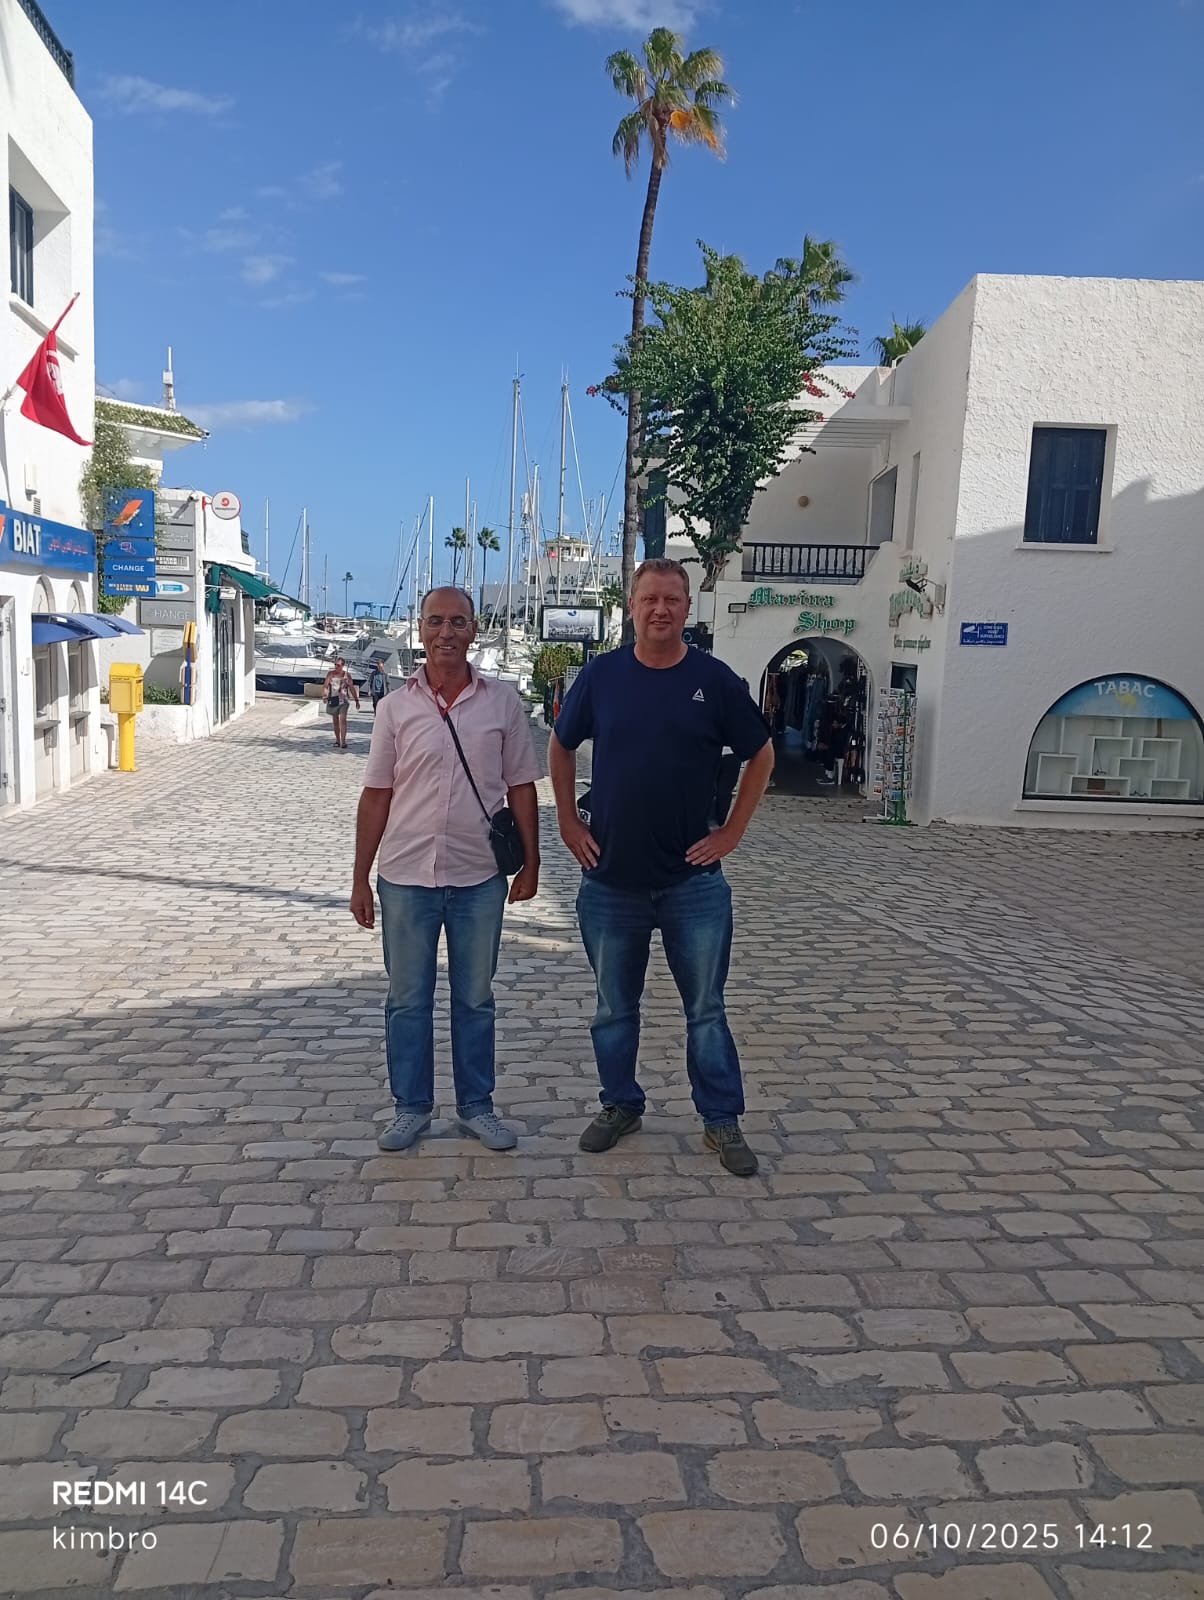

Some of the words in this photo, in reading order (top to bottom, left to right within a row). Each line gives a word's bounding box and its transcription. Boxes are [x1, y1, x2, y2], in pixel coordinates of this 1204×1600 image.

[13, 518, 41, 556] BIAT
[112, 564, 145, 572] CHANGE
[748, 586, 835, 609] Marina
[793, 610, 857, 634] Shop
[1094, 680, 1157, 698] TABAC
